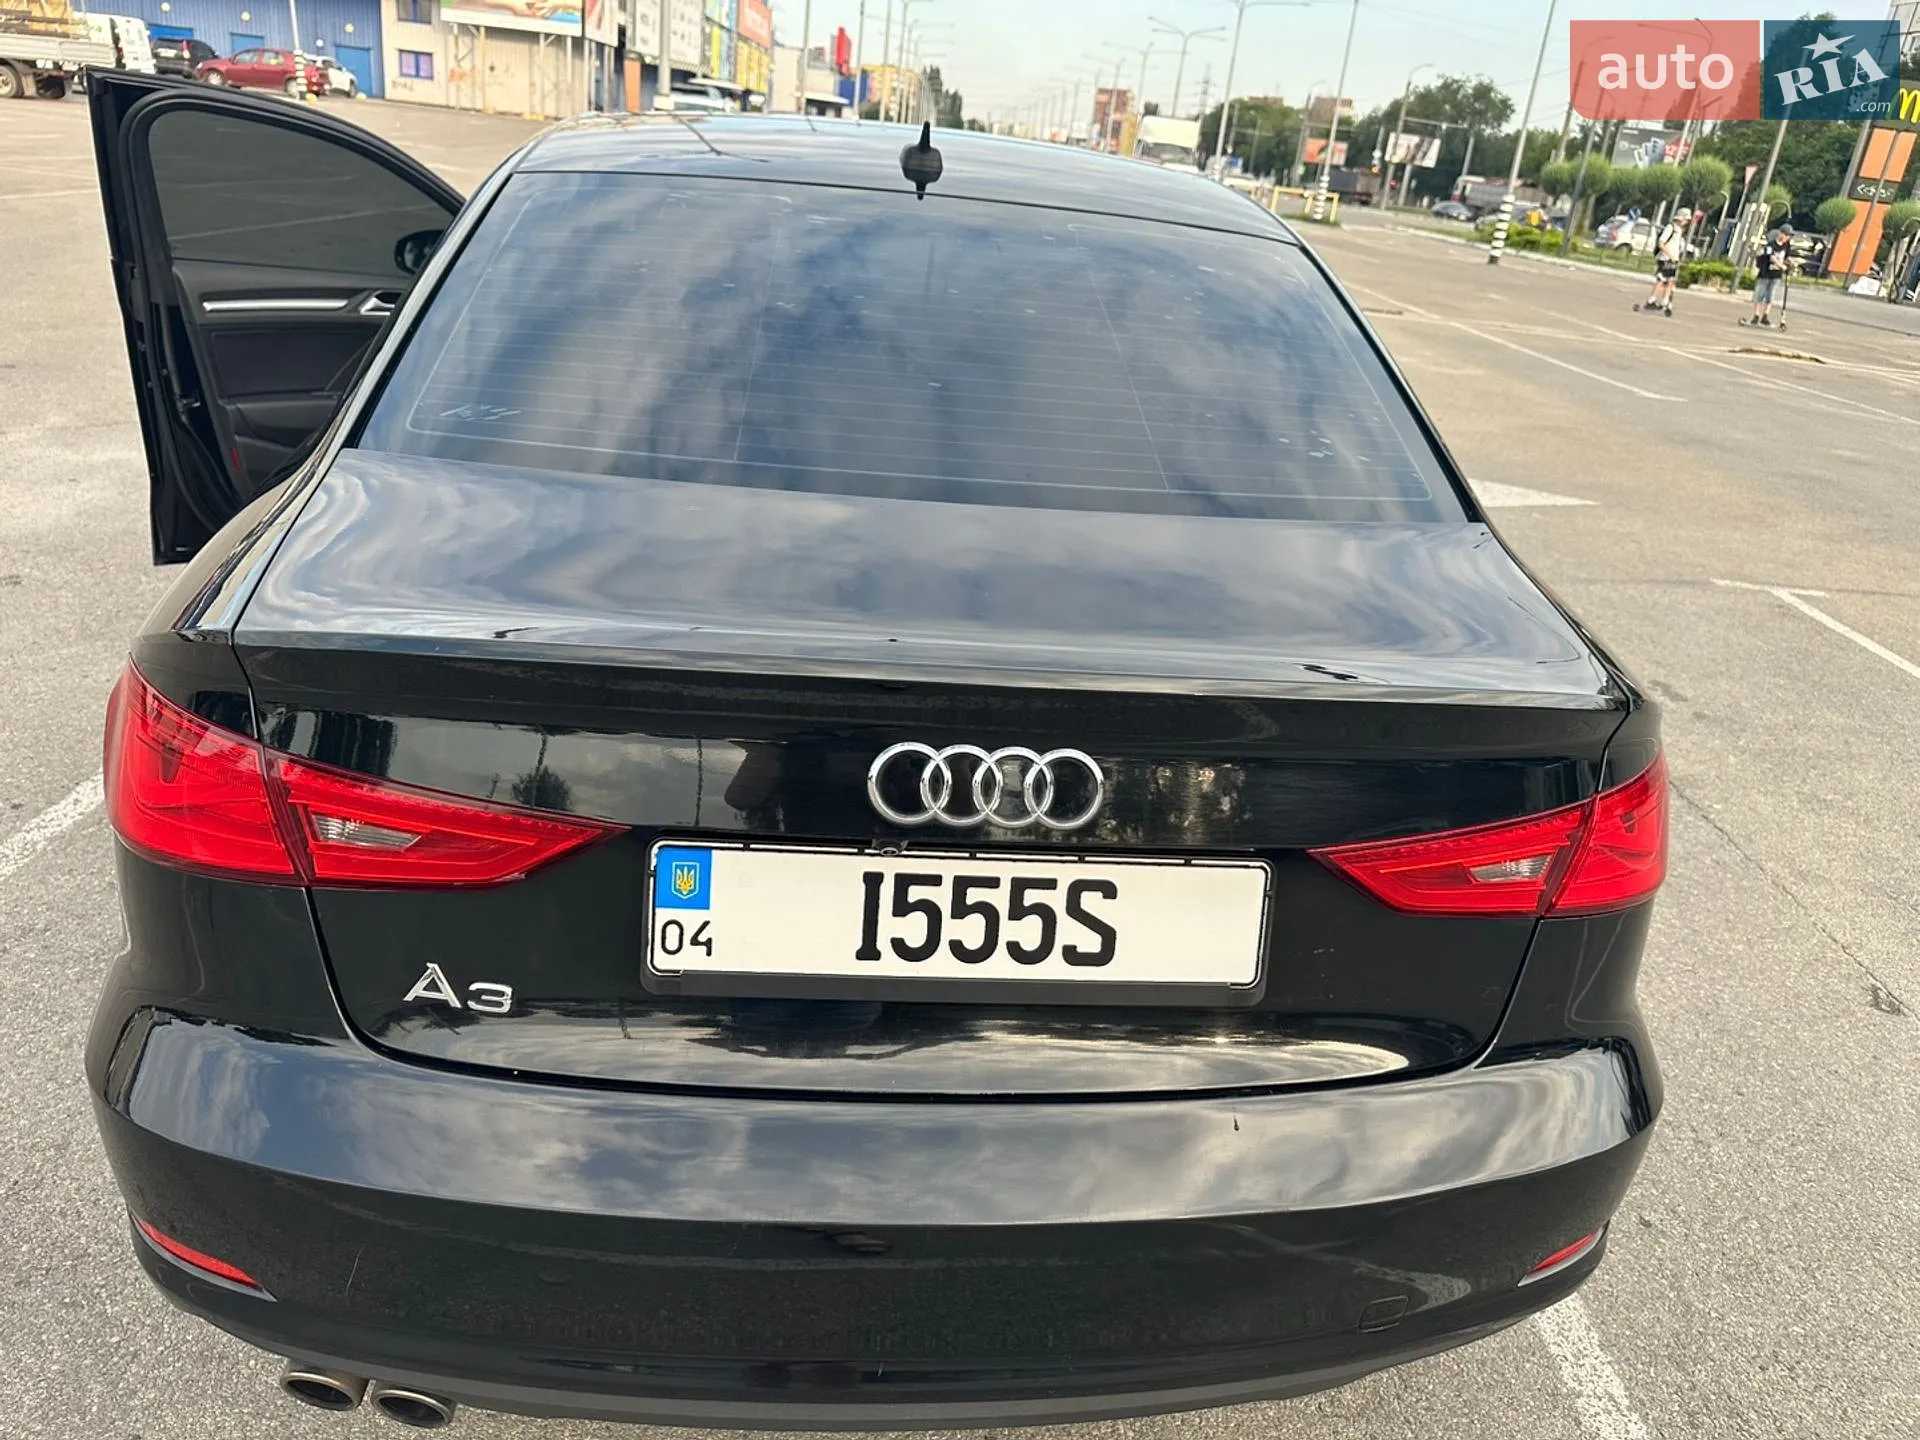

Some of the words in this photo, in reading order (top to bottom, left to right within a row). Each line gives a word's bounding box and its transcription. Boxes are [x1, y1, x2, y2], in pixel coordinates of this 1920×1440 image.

[661, 918, 713, 957] 04
[855, 871, 1118, 967] I555S
[402, 962, 513, 1014] A3
